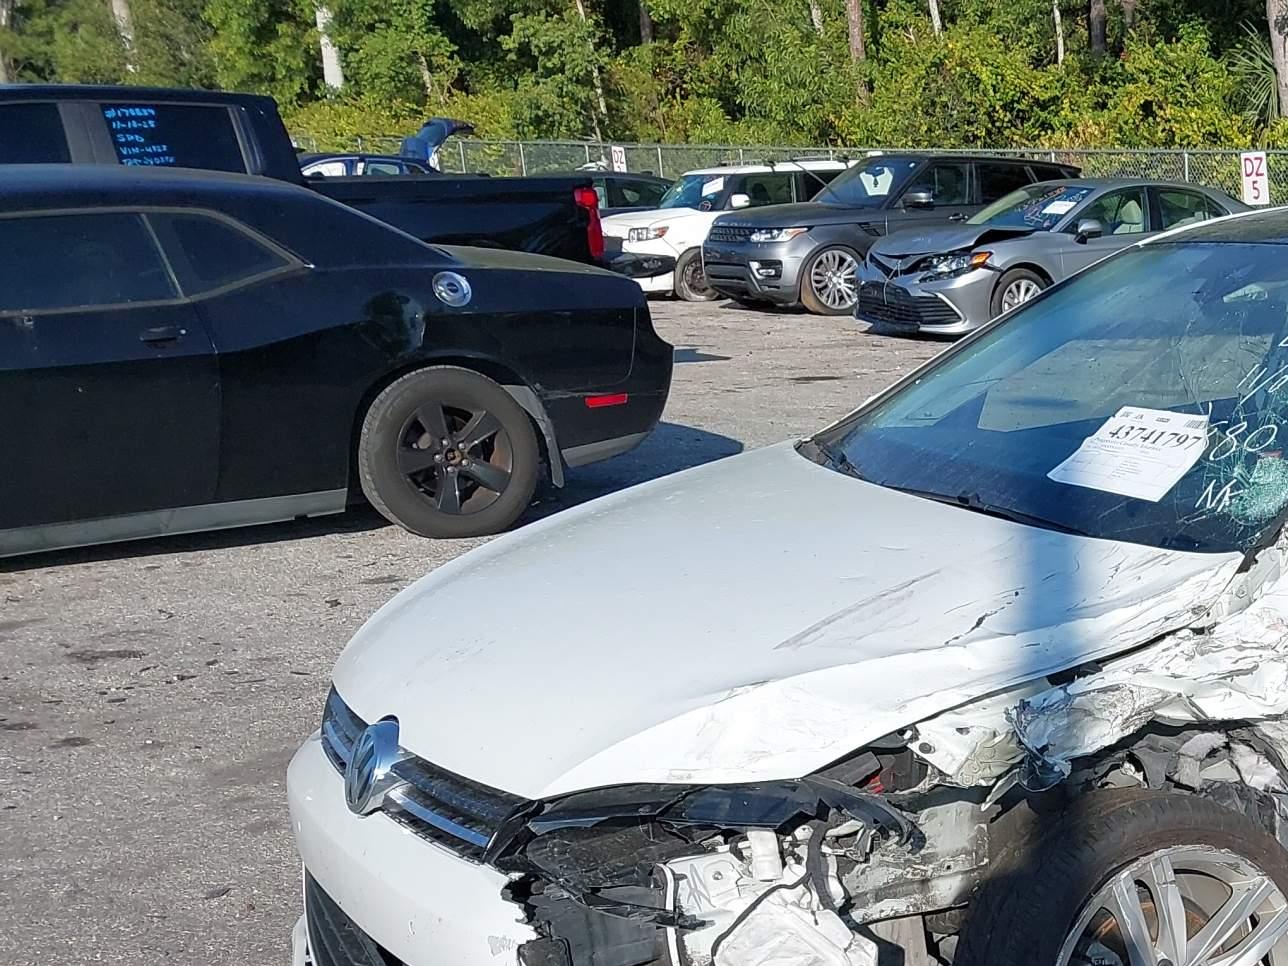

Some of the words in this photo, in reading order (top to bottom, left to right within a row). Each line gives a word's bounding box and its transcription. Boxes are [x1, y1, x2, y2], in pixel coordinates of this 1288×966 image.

[613, 150, 625, 165] DZ
[1244, 156, 1265, 177] DZ
[1252, 180, 1261, 200] 5
[1108, 424, 1203, 451] 43741797
